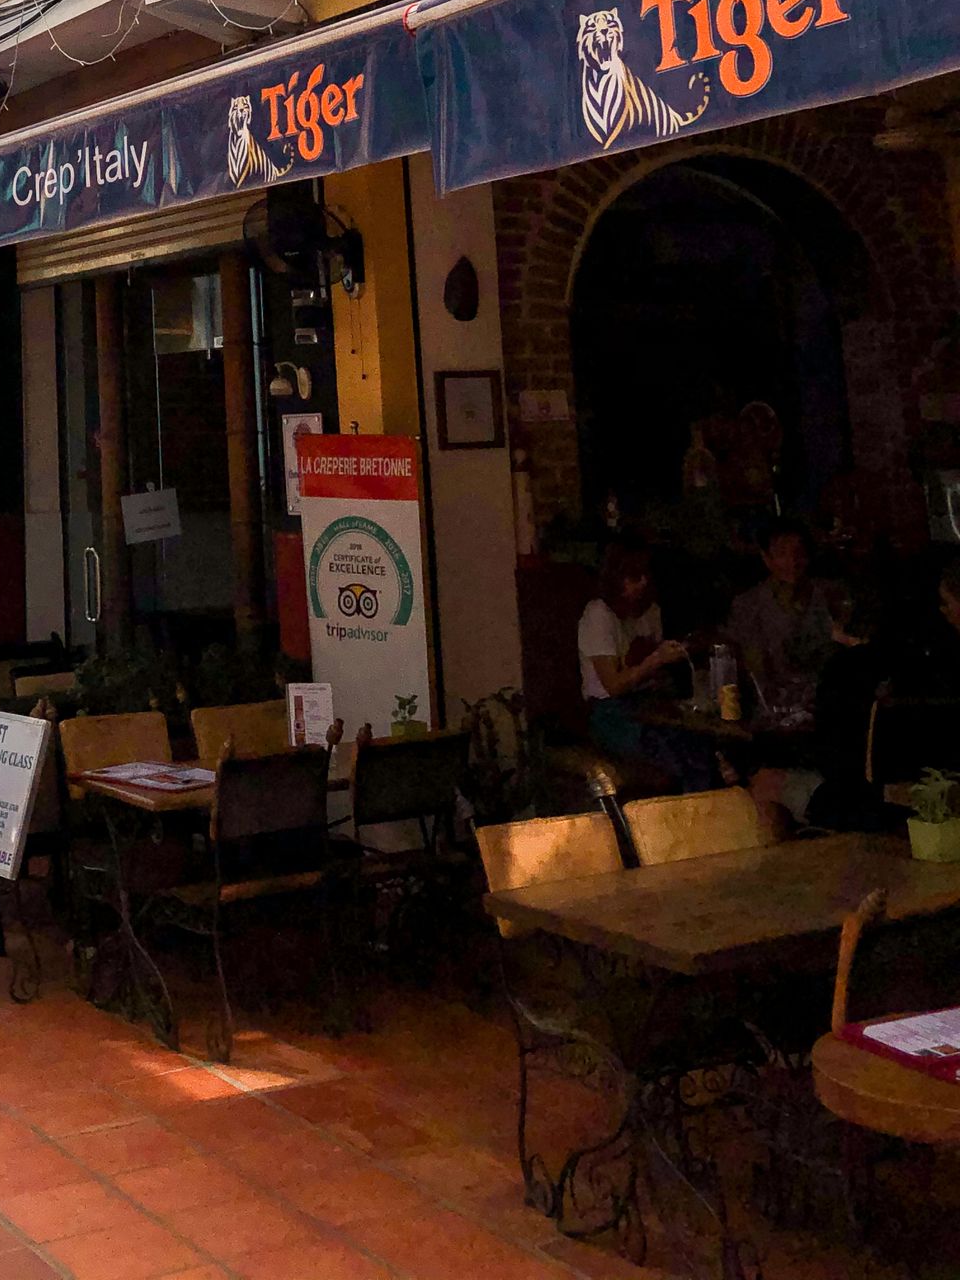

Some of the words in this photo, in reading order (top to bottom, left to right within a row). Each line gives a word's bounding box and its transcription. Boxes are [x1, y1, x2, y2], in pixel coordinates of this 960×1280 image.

[261, 63, 365, 162] Tiger
[12, 136, 149, 207] Crep'Italy
[301, 457, 314, 474] LA
[314, 457, 357, 476] CREPERIE
[359, 457, 412, 477] BRETONNE
[333, 554, 374, 565] CERTIFICATE
[329, 562, 386, 577] EXCELLENCE
[326, 623, 389, 642] tripadvisor
[8, 752, 34, 770] CLASS
